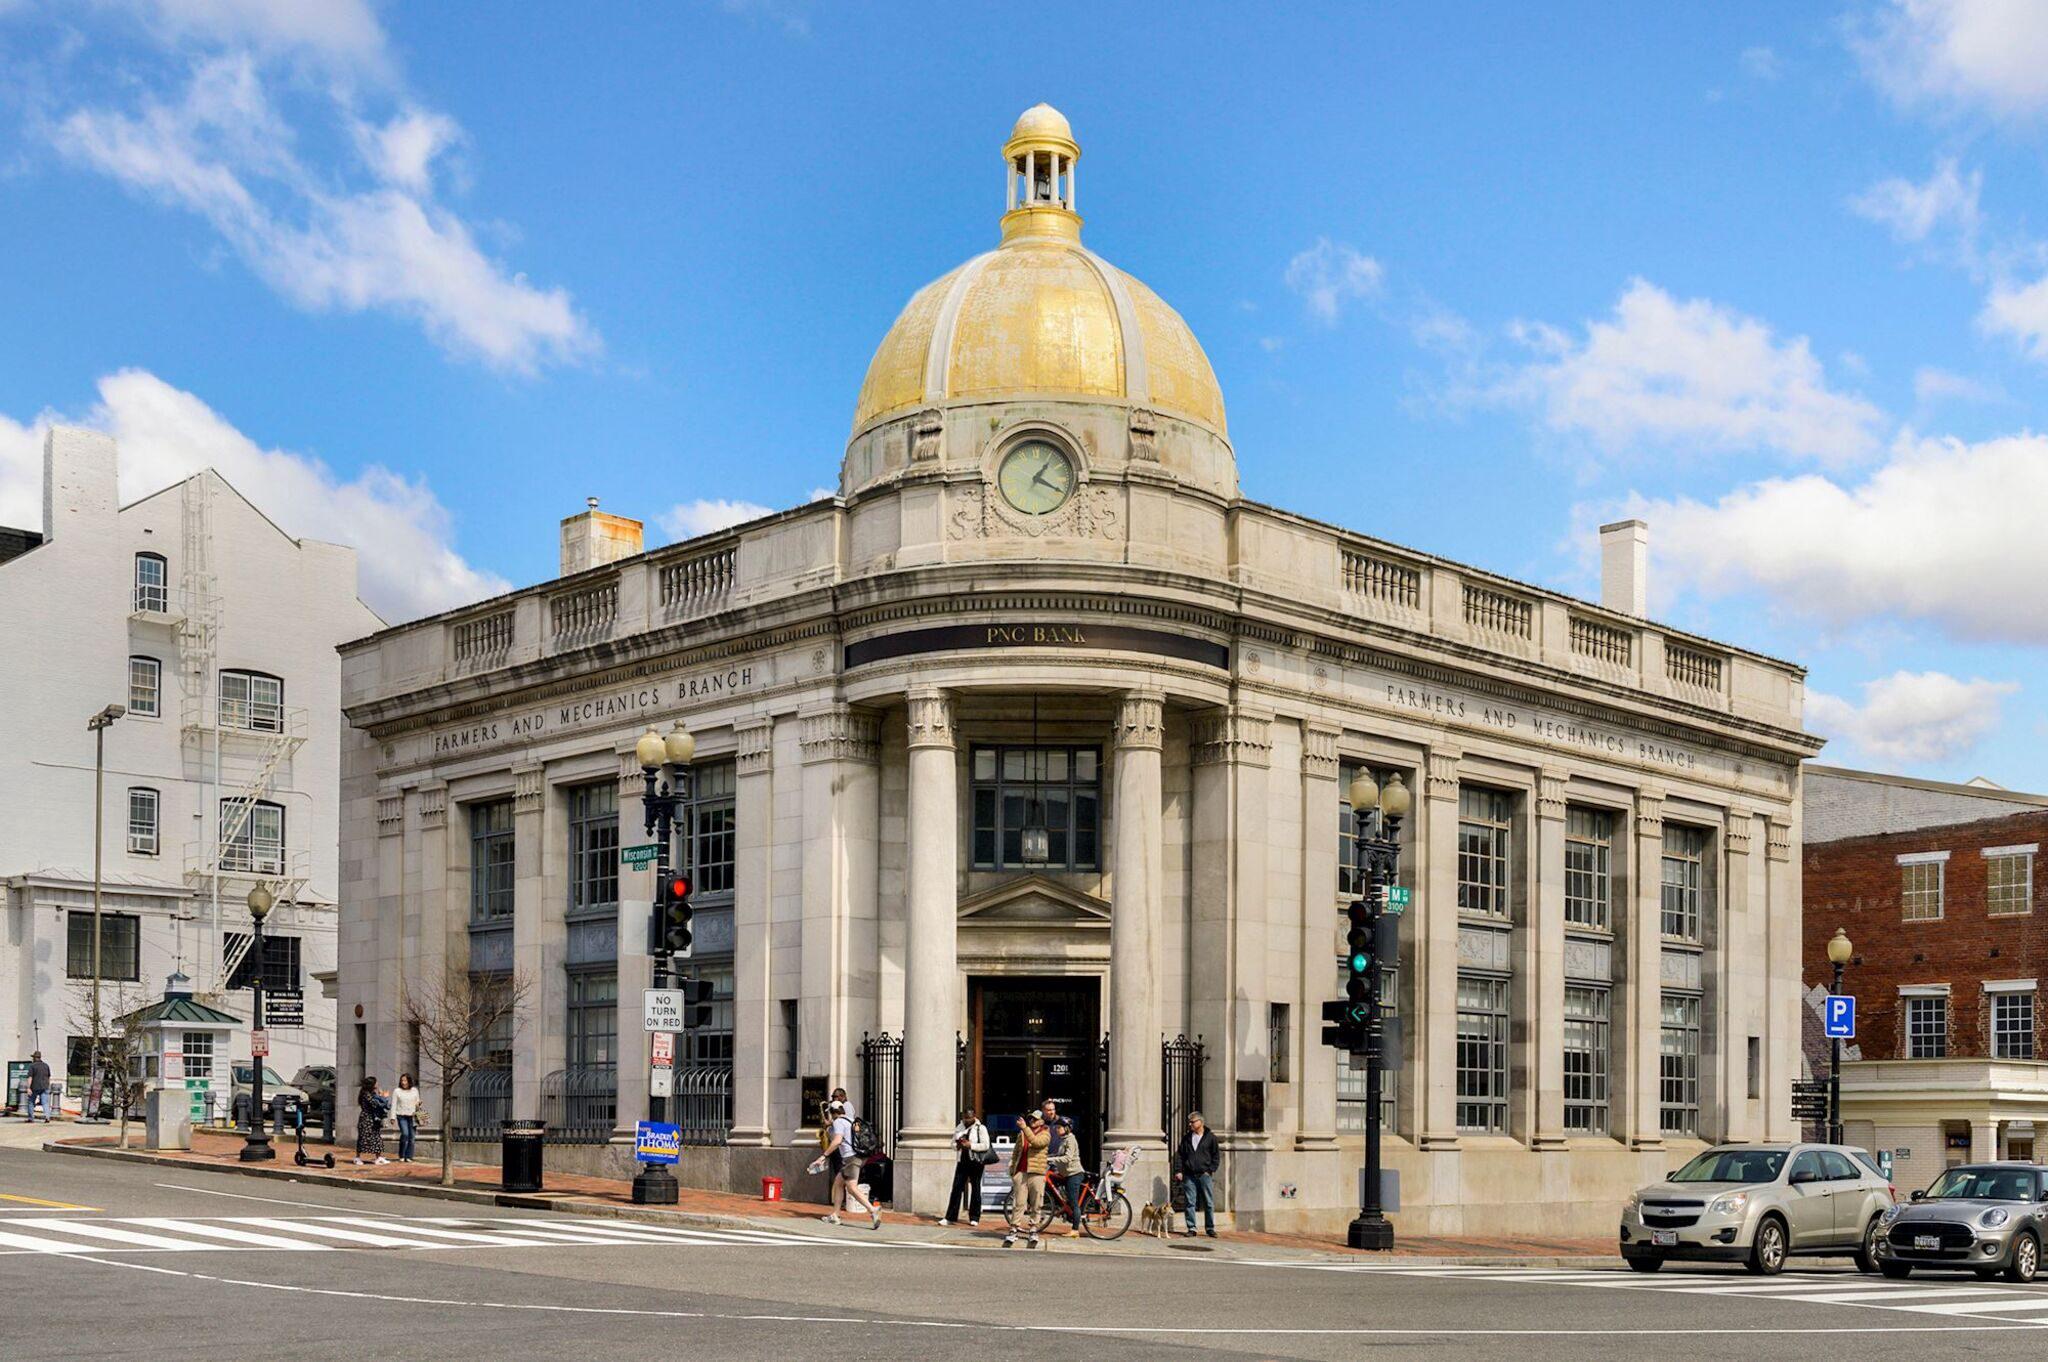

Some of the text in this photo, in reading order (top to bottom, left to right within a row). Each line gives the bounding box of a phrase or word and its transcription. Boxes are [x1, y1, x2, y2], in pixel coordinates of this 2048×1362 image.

[987, 627, 1088, 644] PNC BANK
[434, 667, 753, 753] FARMERS AND MECHANICS BRANCH
[1387, 685, 1696, 770] FARMERS AND MECHANICS BRANCH
[623, 848, 652, 861] Wisconsin
[1391, 889, 1400, 901] M
[1387, 902, 1404, 912] 3100
[656, 996, 671, 1005] NO
[651, 1007, 677, 1016] TURN
[1833, 1000, 1847, 1022] P
[646, 1018, 681, 1027] ON RED
[1053, 1064, 1069, 1072] 1201
[646, 1131, 673, 1141] BRADLEY
[638, 1136, 680, 1149] THOMAS
